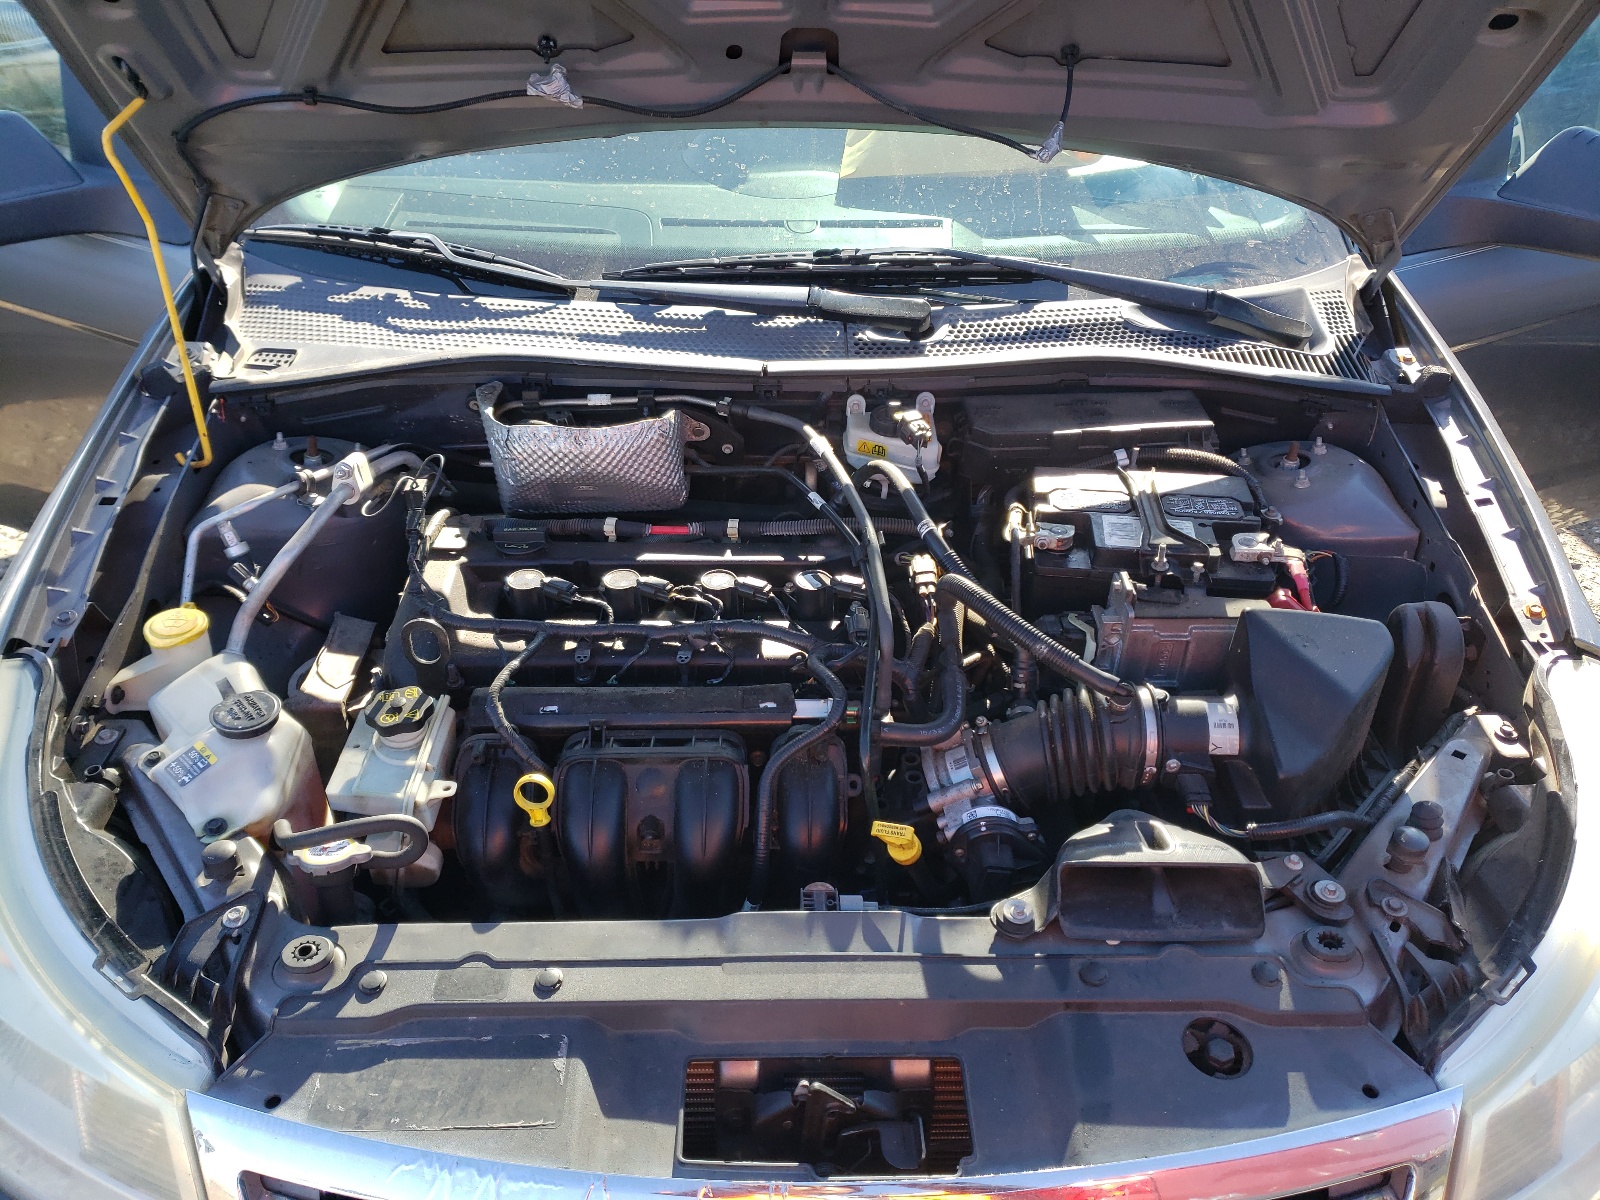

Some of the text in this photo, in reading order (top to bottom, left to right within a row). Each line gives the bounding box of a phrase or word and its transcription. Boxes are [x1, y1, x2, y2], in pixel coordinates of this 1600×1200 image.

[1211, 742, 1223, 752] Y
[188, 749, 200, 763] 50%
[890, 829, 906, 837] TRANS
